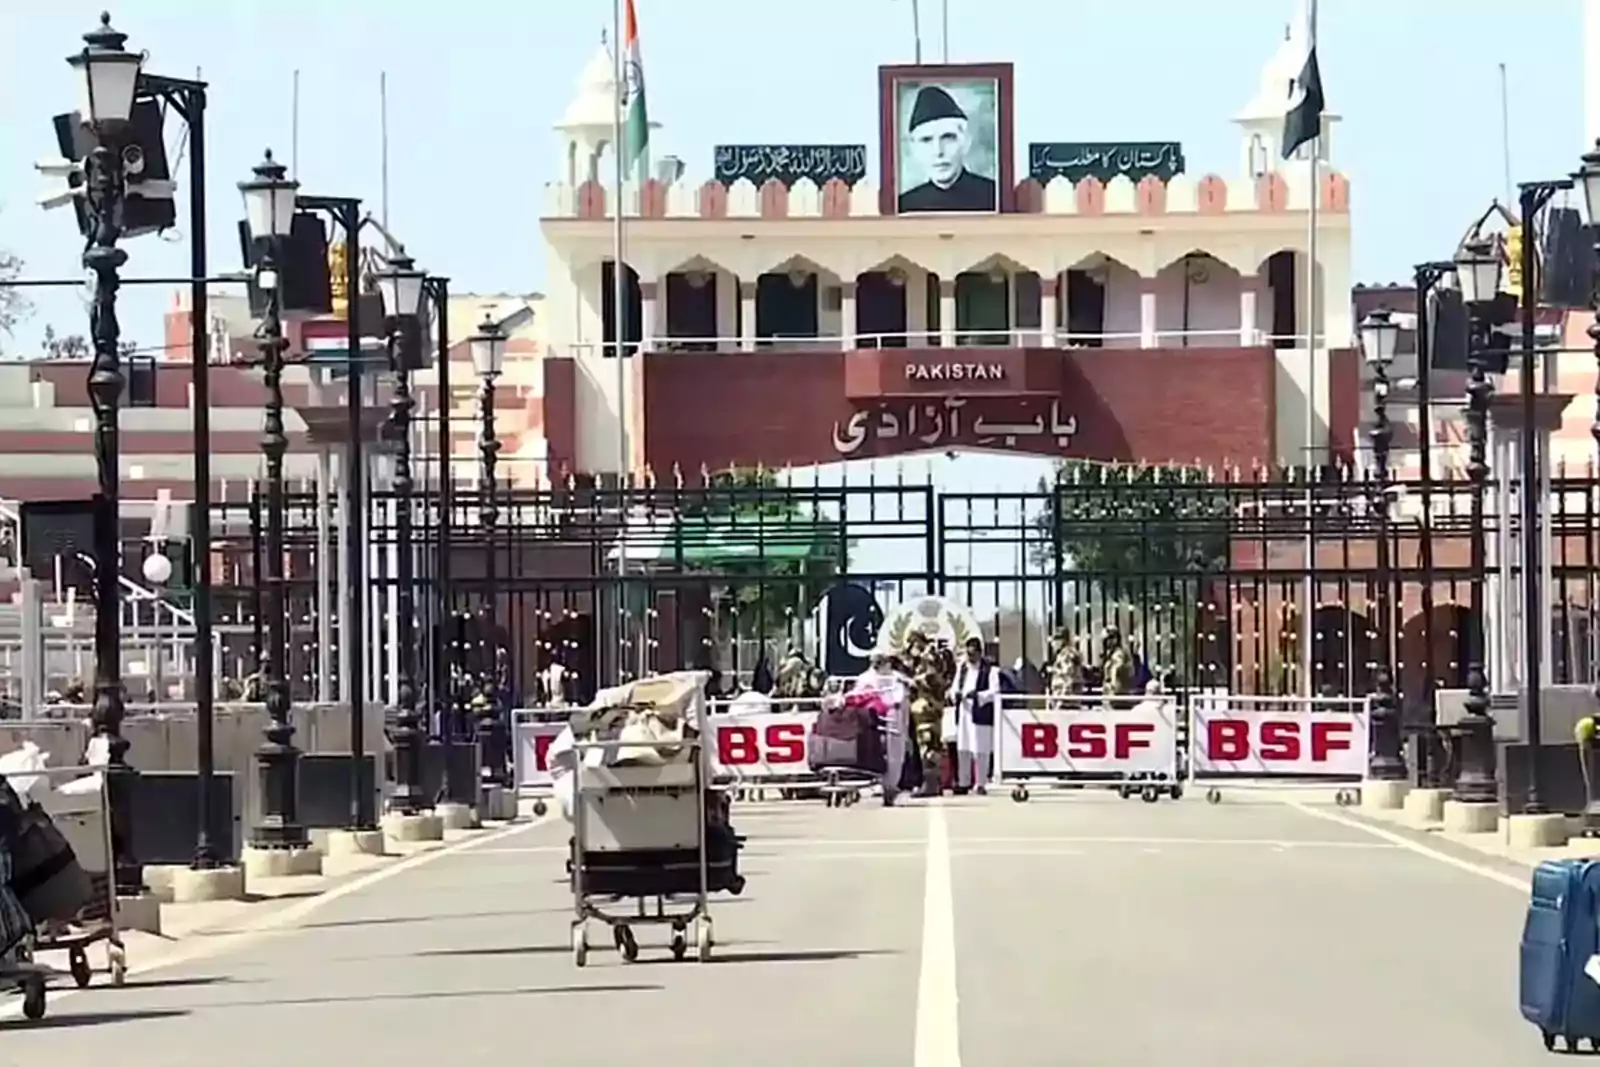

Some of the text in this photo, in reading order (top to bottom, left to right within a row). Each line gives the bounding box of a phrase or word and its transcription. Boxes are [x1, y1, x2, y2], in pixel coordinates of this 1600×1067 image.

[1046, 147, 1100, 172] مطلب
[1117, 144, 1178, 172] پاکستان
[904, 363, 1002, 379] PAKISTAN
[717, 724, 819, 765] BS
[1021, 723, 1155, 759] BSF
[1207, 719, 1354, 762] BSF
